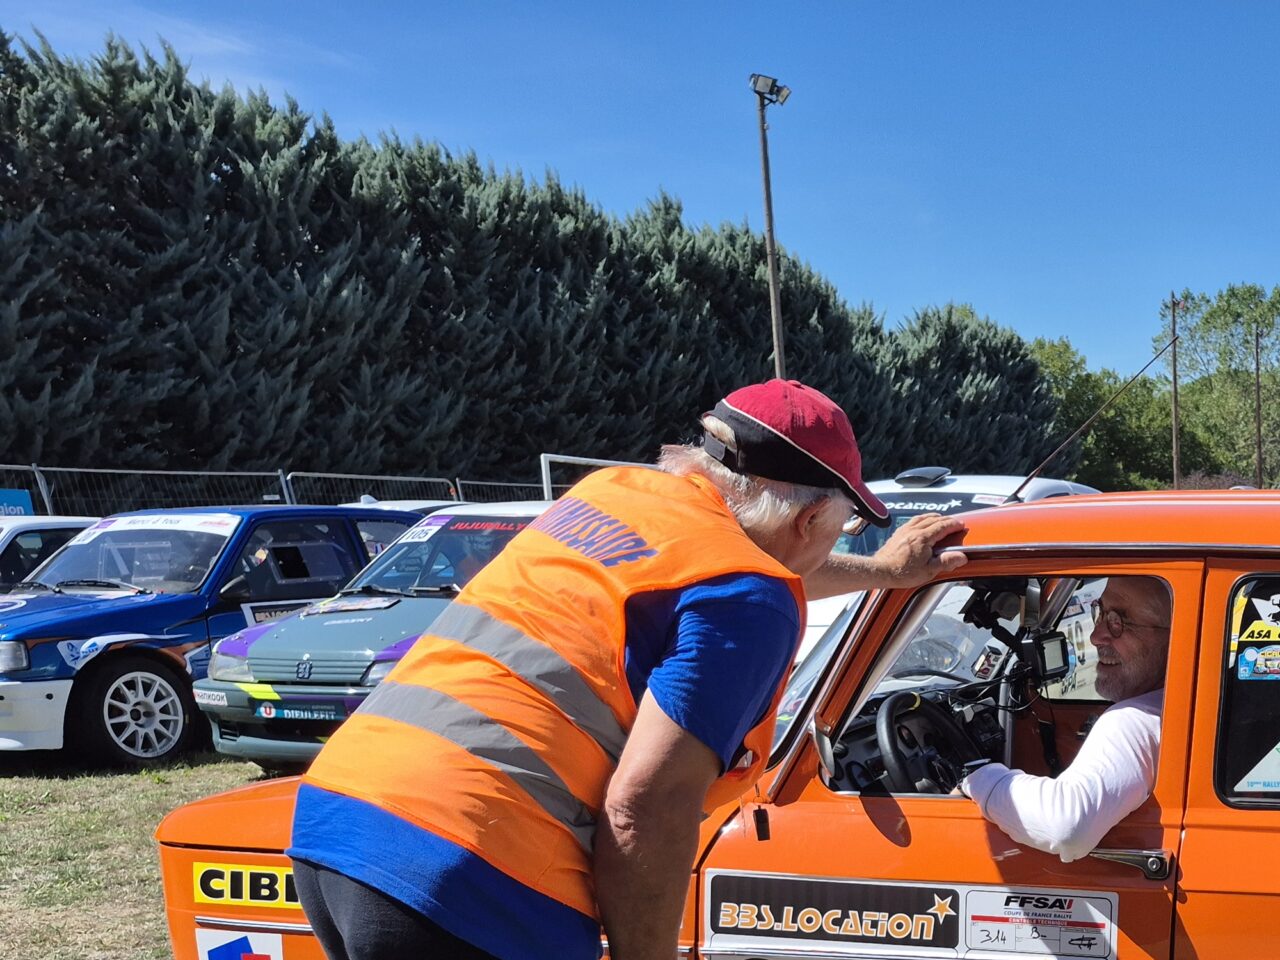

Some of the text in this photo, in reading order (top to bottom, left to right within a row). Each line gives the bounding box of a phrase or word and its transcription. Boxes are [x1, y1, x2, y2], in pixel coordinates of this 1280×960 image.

[1245, 629, 1271, 639] ASA
[199, 869, 300, 902] CIBI
[1004, 895, 1070, 910] FFSA
[980, 929, 1007, 943] 314
